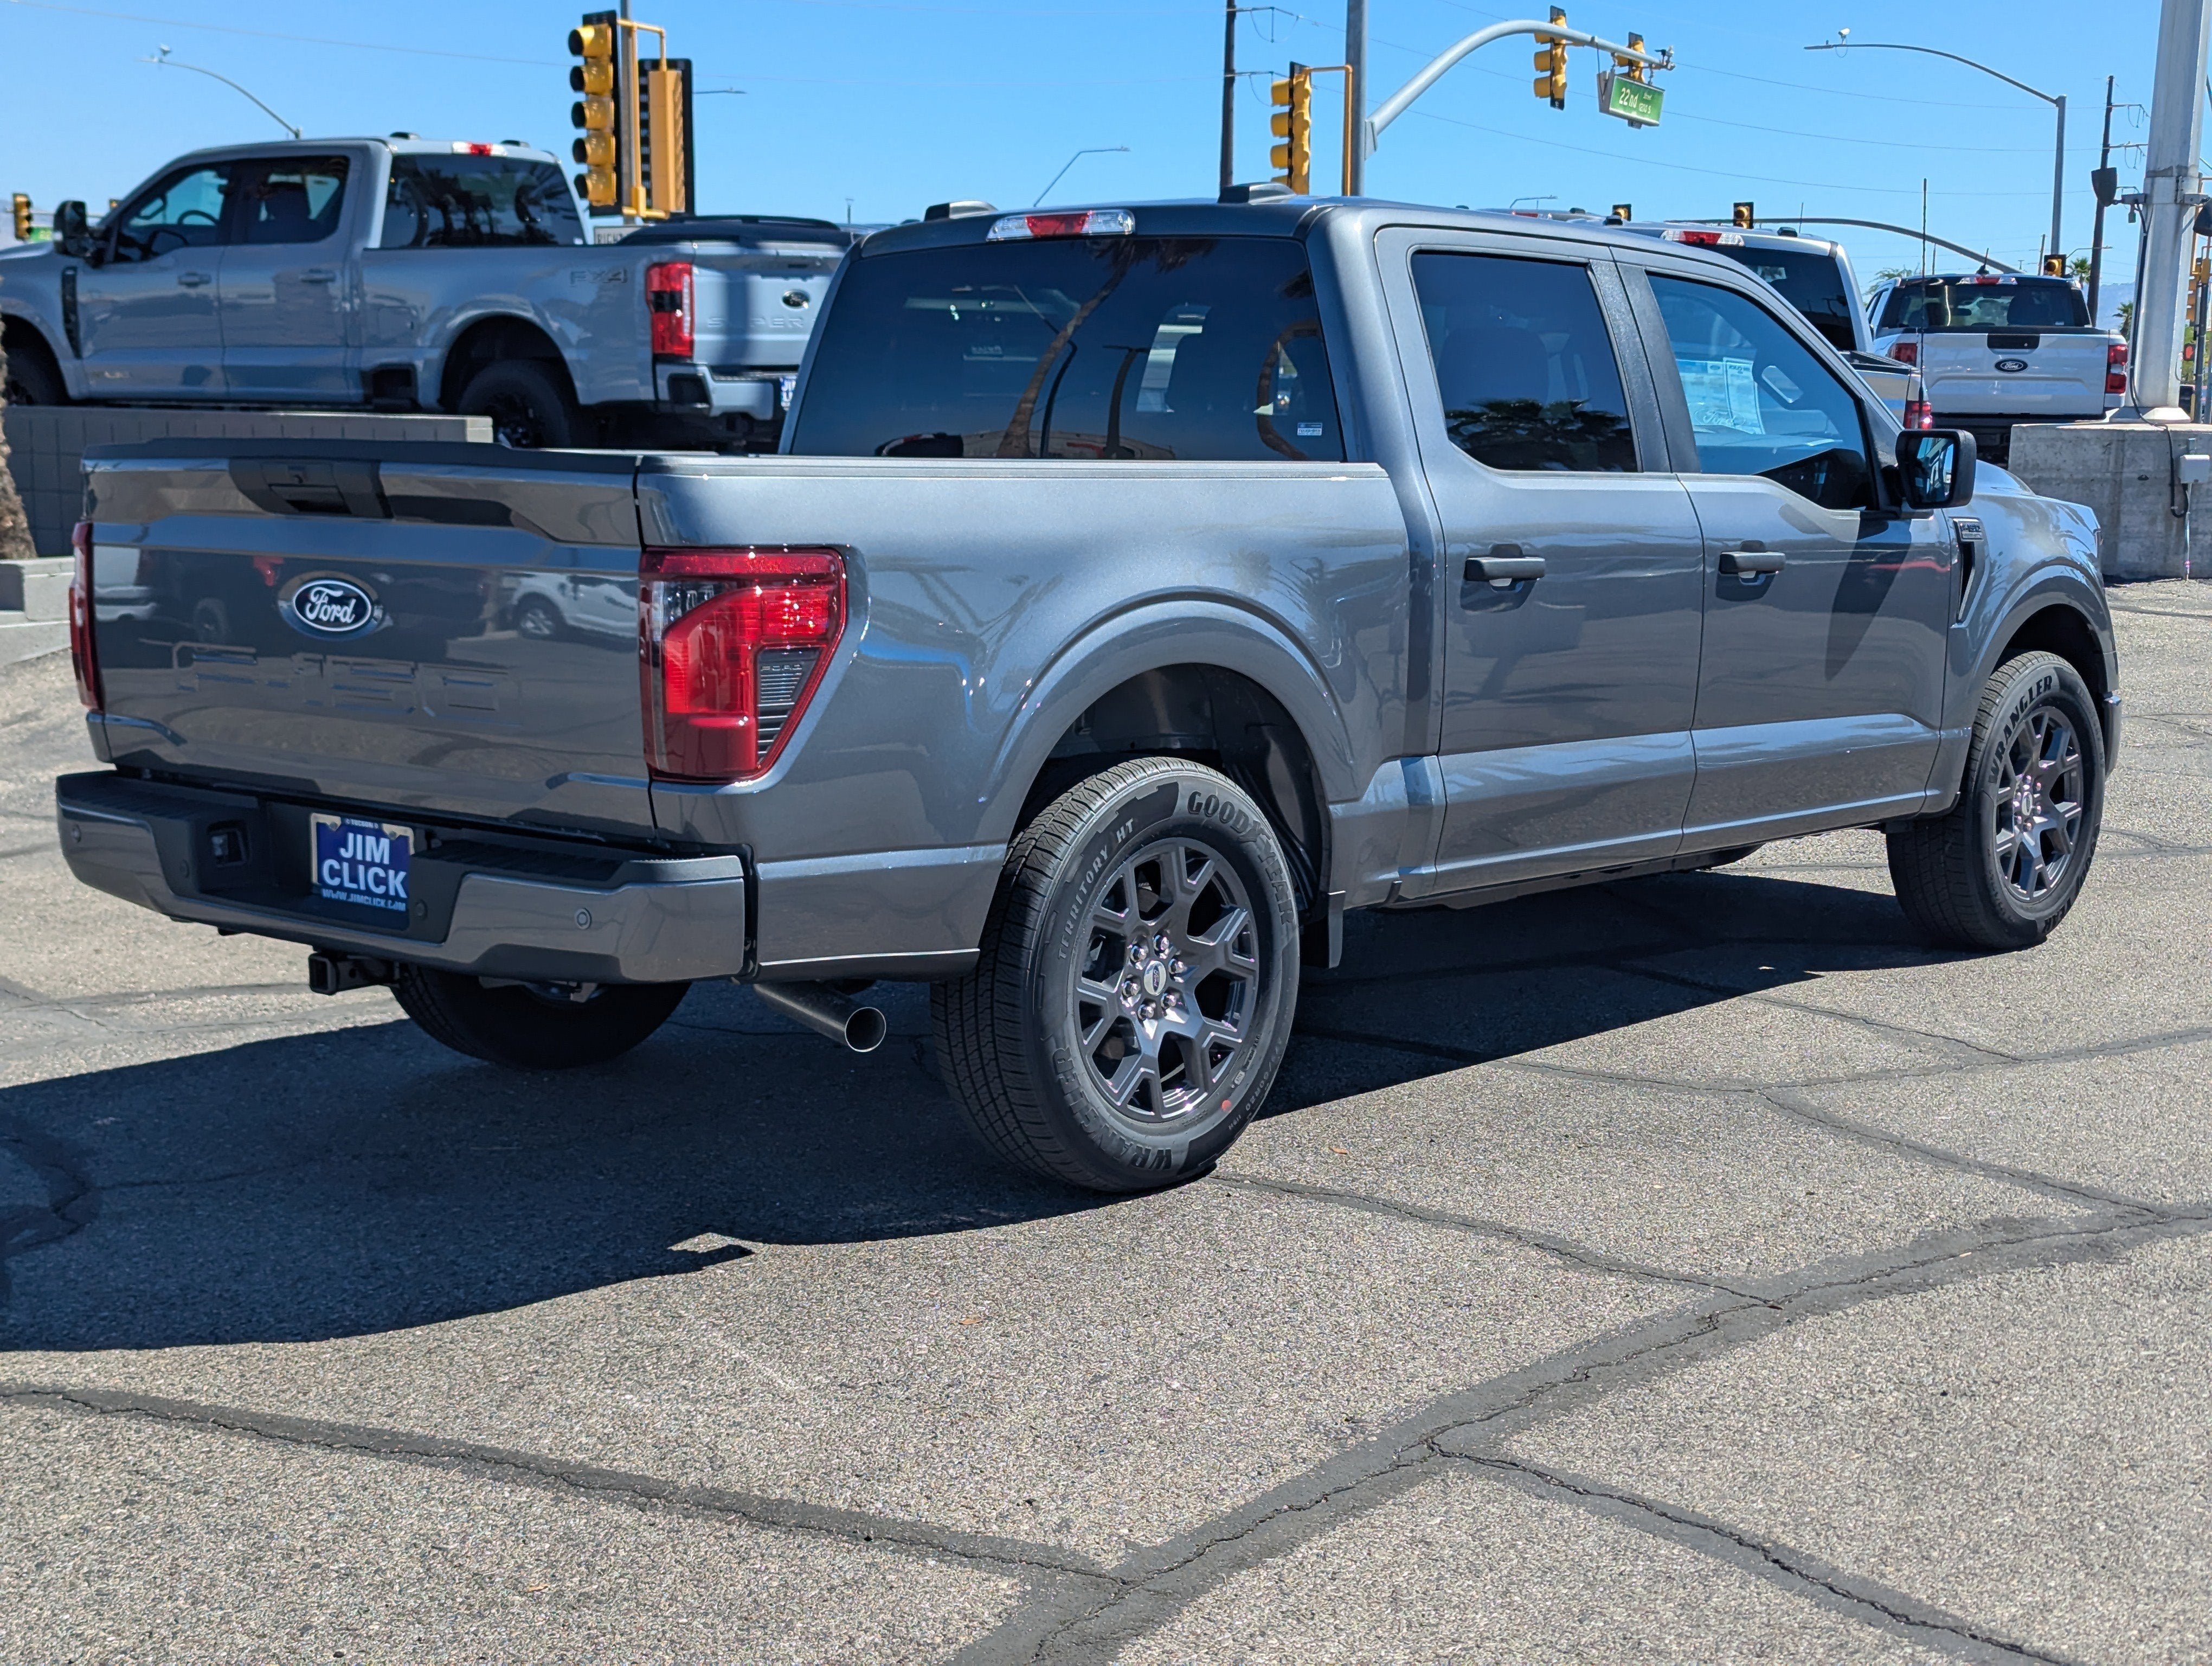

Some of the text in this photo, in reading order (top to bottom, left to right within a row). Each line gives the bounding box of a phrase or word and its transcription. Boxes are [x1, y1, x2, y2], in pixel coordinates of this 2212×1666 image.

[1619, 87, 1639, 108] 22nd
[570, 269, 627, 285] FX4
[707, 317, 803, 328] SPER
[305, 586, 356, 624] Ford
[1988, 675, 2053, 784] WRANGLER
[339, 832, 390, 864] JIM
[1187, 791, 1295, 925] GOODYEAR
[322, 858, 407, 898] CLICK
[1058, 818, 1134, 959] TERRITORY HT
[1053, 1046, 1172, 1170] WRANGLER
